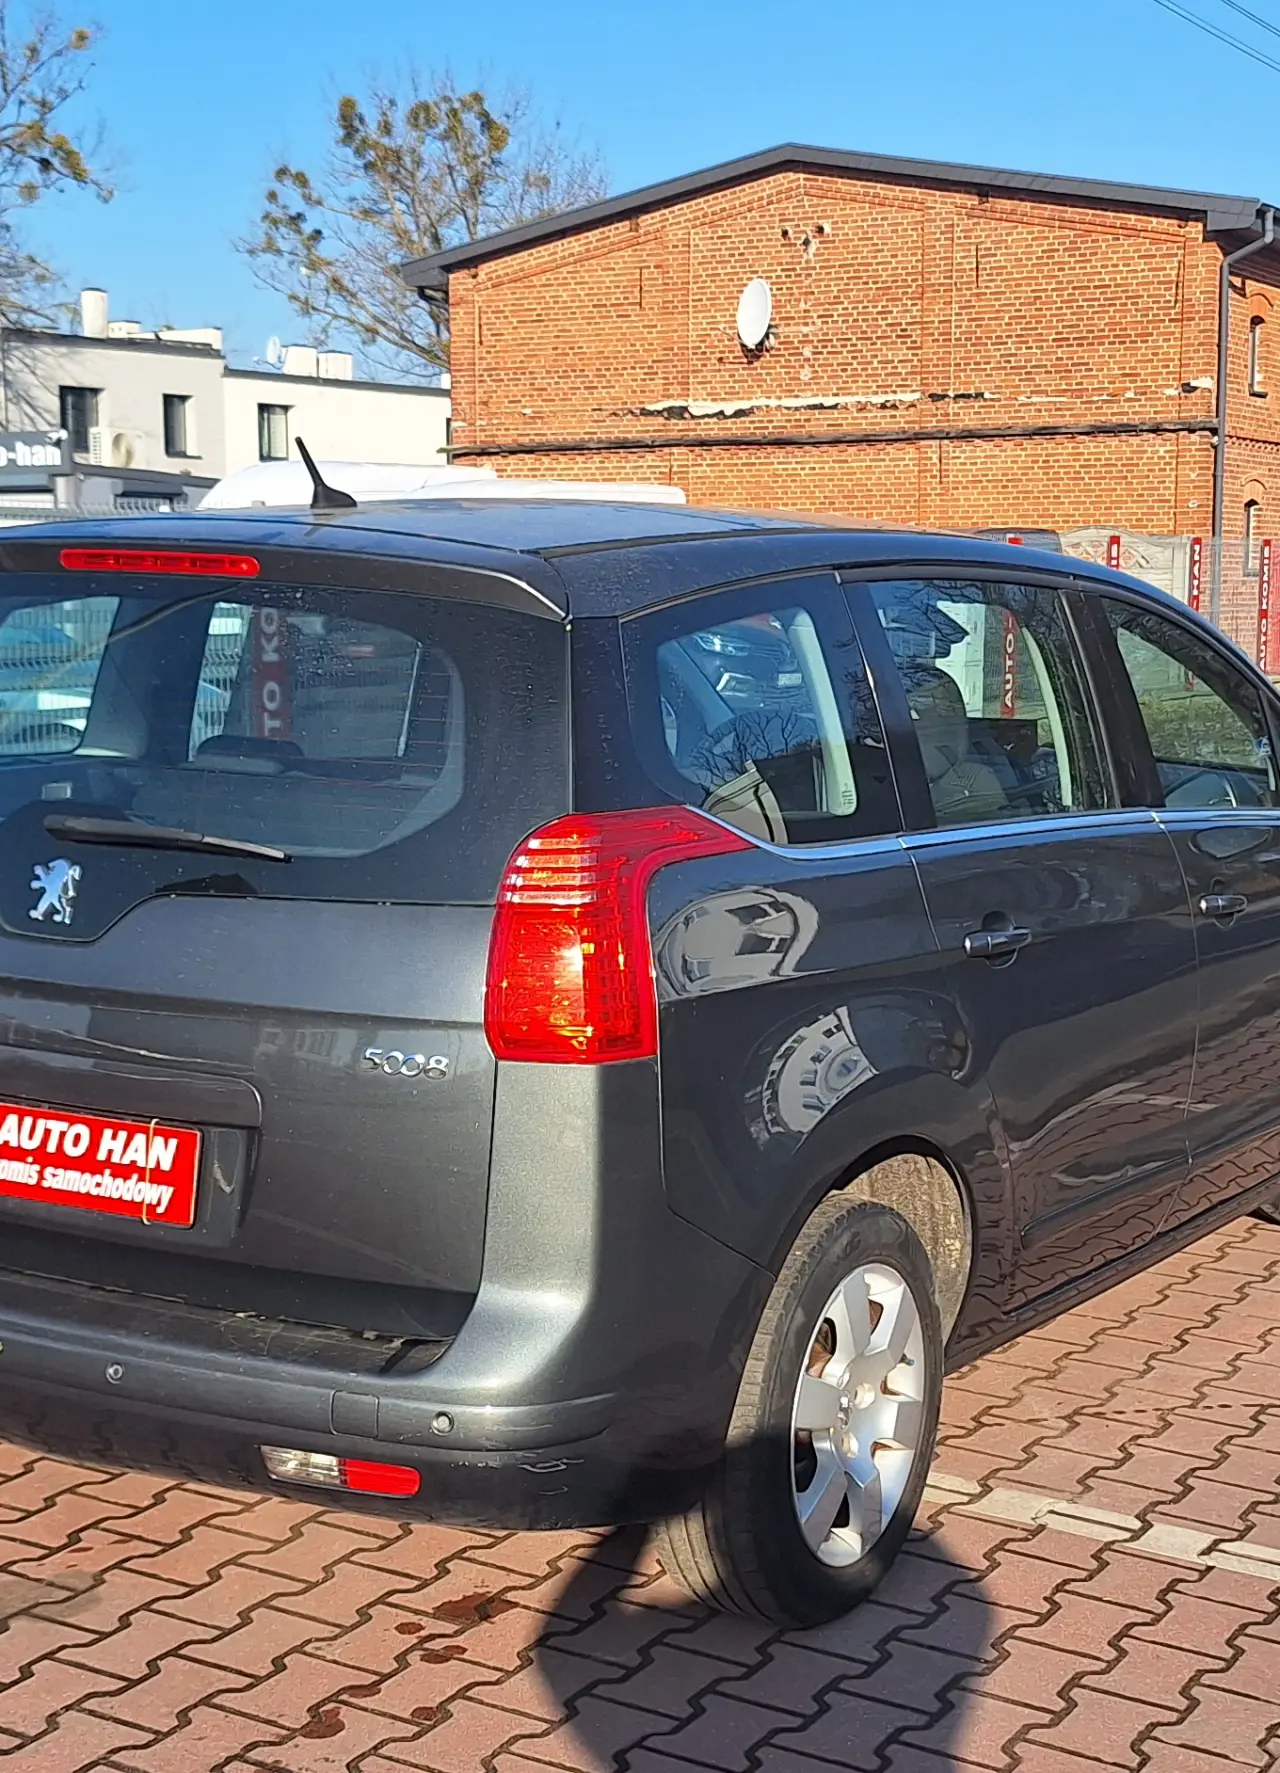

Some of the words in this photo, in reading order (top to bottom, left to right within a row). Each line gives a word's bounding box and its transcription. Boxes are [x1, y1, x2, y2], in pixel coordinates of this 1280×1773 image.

[358, 1047, 450, 1081] 5008
[96, 1129, 177, 1171] HAN
[43, 1164, 175, 1214] samochodowy
